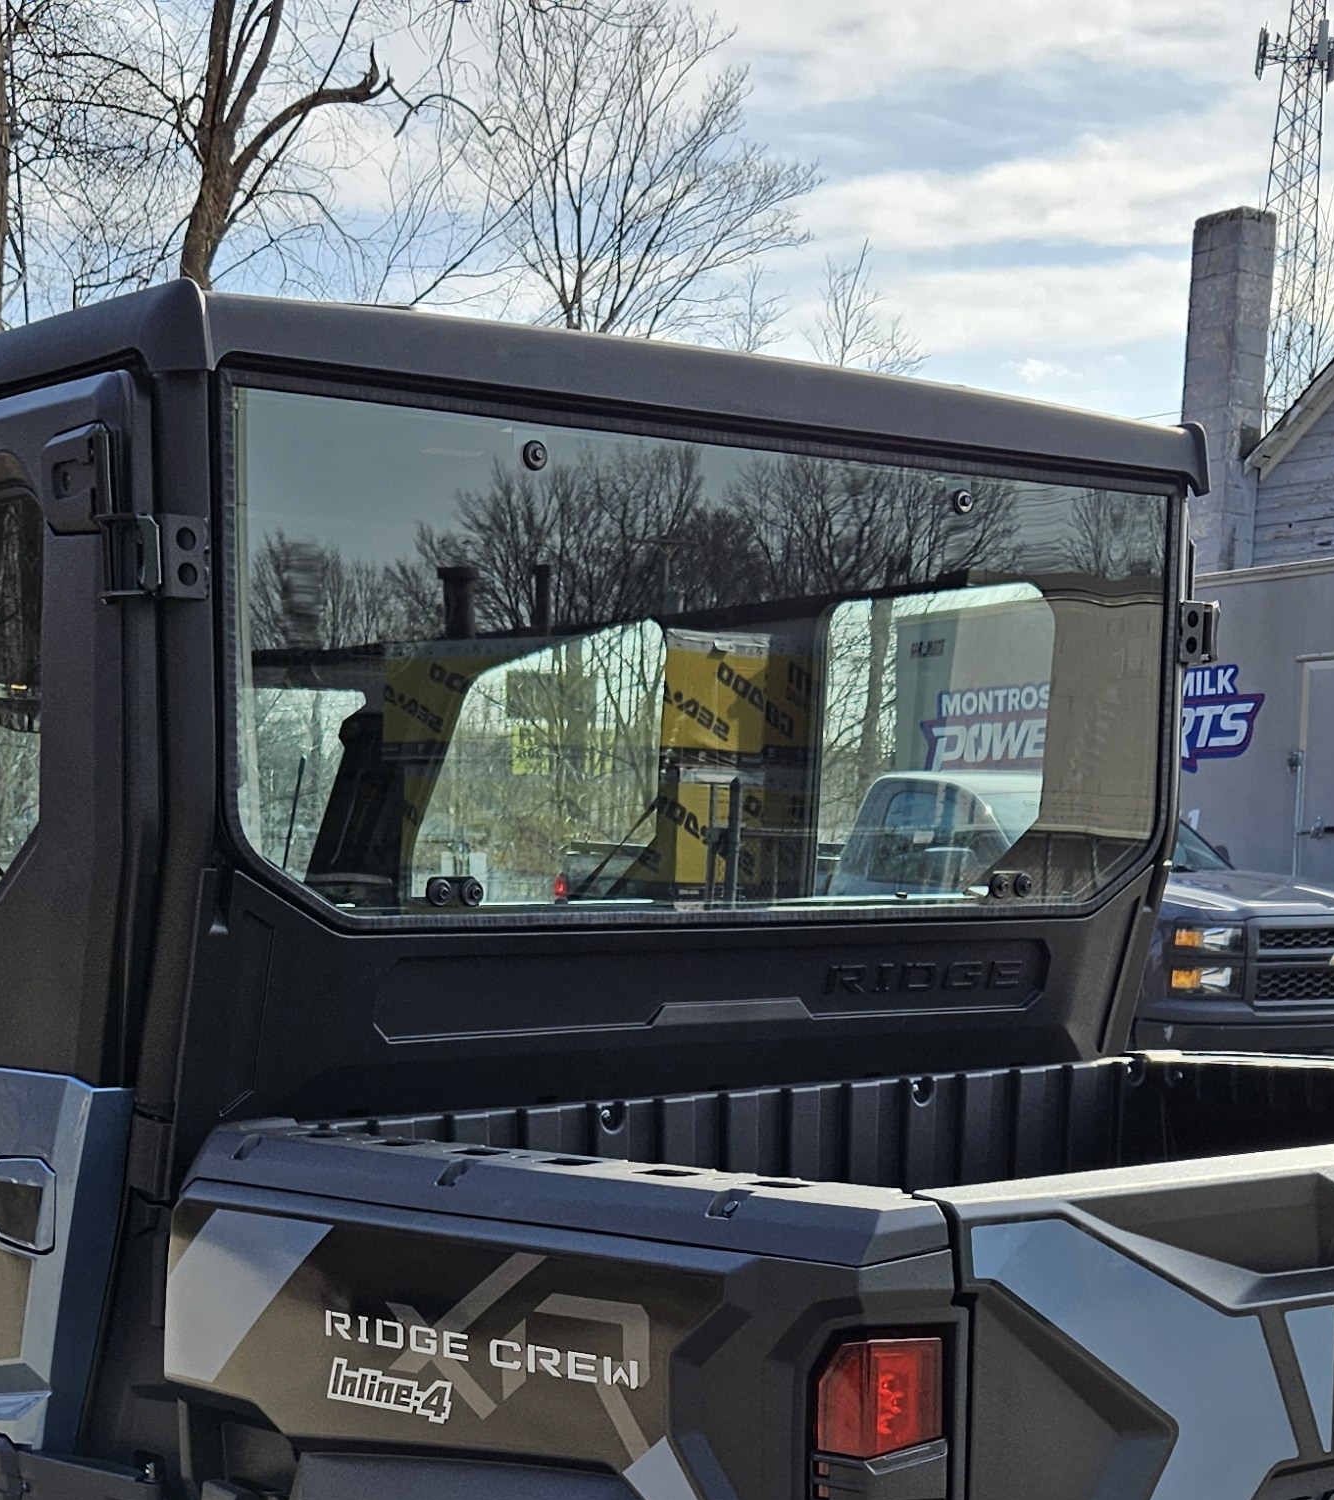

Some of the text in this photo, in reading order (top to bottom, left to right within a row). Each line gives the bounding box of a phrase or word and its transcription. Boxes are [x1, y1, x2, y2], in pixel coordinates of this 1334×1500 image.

[822, 959, 1025, 996] RIDGE
[324, 1309, 640, 1390] RIDGE CREW
[326, 1356, 453, 1425] Inline-4
